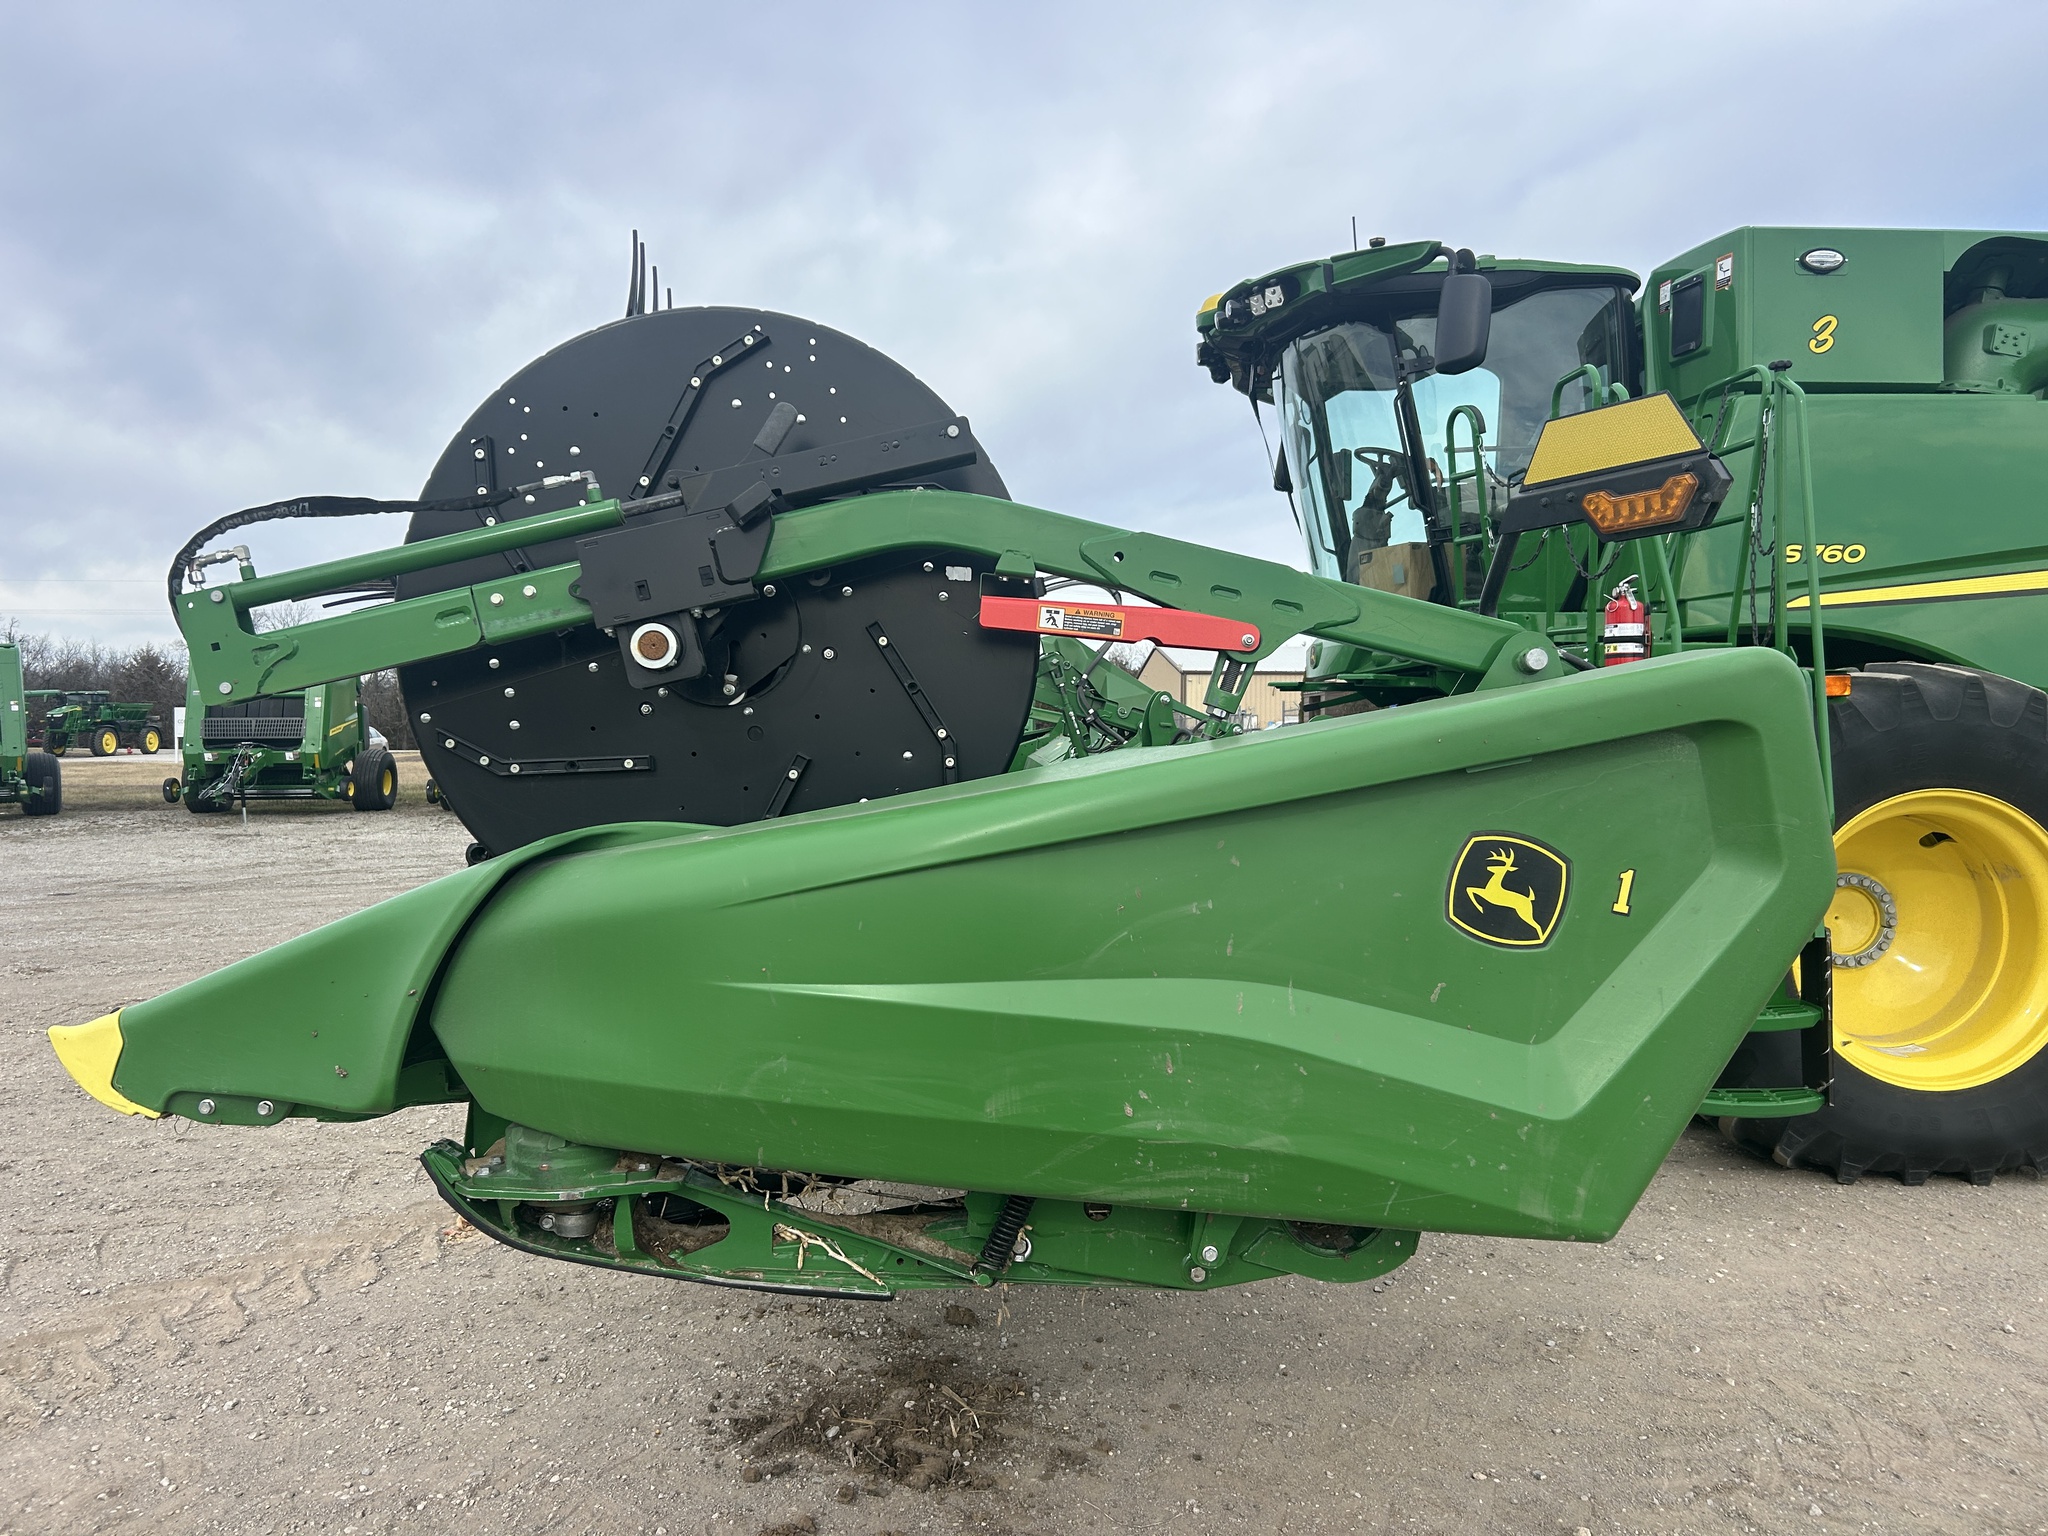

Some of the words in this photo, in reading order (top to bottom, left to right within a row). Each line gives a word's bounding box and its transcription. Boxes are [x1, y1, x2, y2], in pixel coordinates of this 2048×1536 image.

[1808, 314, 1839, 354] 3
[880, 441, 890, 453] 3
[1083, 609, 1115, 618] WARNING
[1612, 868, 1636, 915] 1
